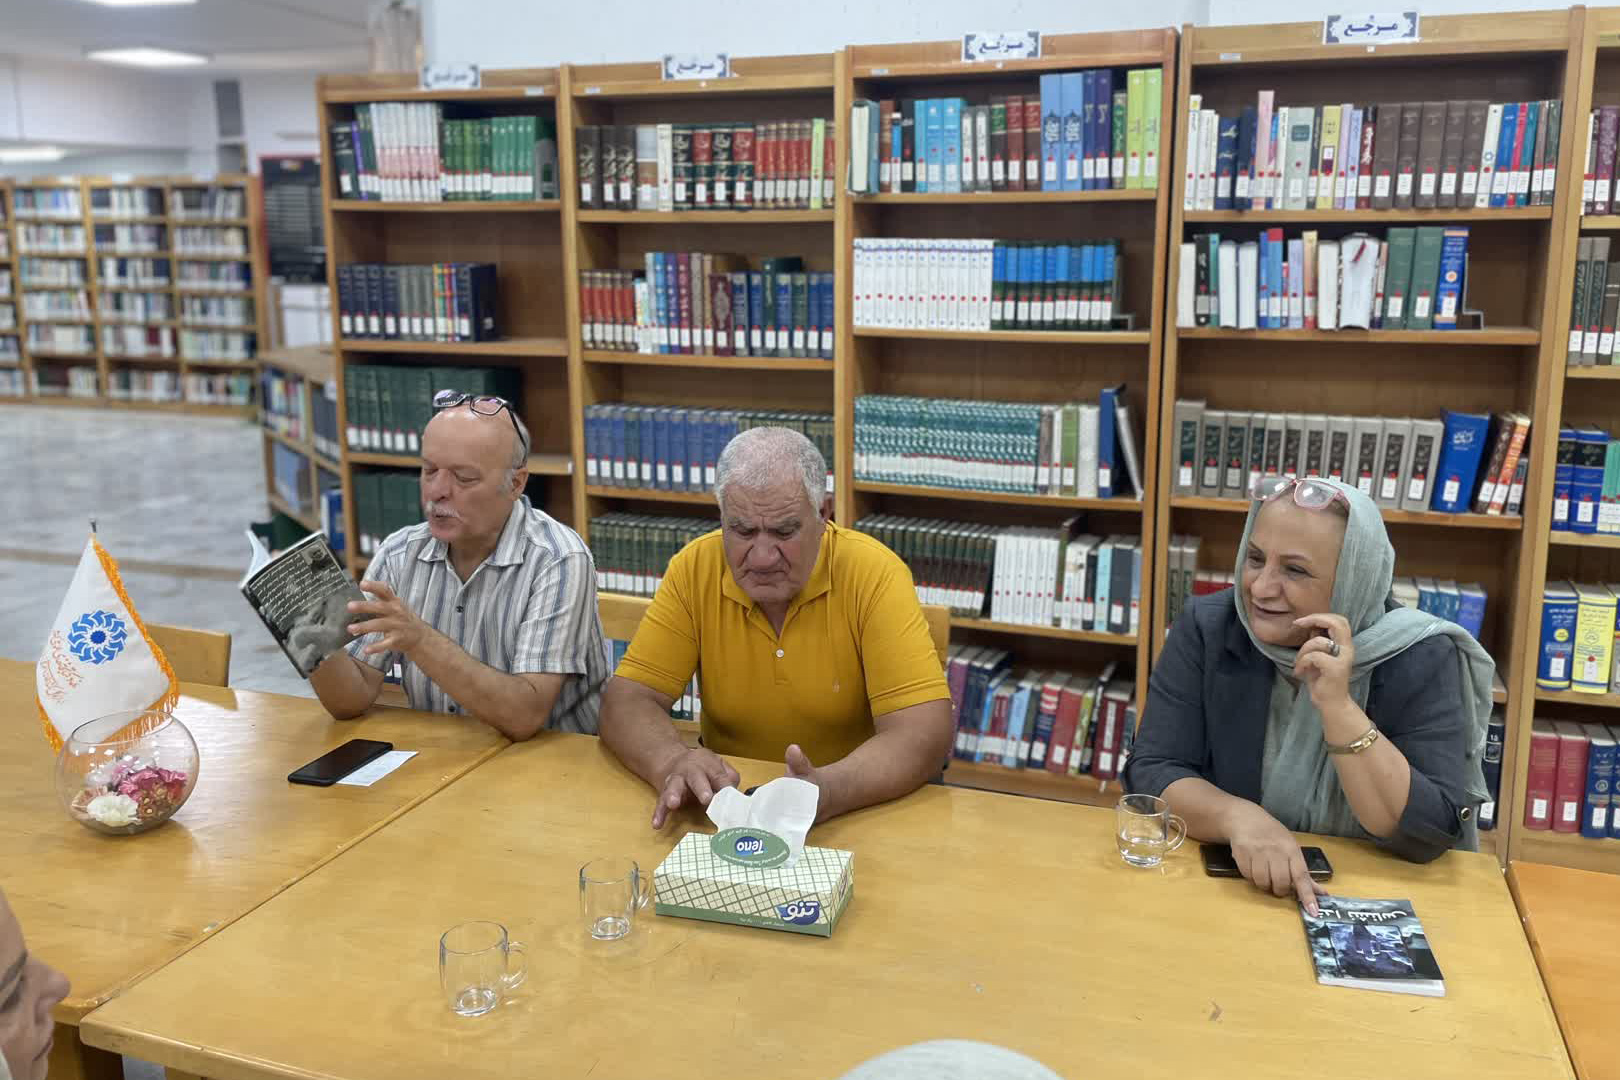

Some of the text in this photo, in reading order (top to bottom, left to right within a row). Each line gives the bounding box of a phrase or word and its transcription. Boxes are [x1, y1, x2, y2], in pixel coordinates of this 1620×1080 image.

[1344, 23, 1398, 36] مرجع
[736, 839, 764, 855] Teno
[782, 901, 818, 921] تنو
[1347, 910, 1408, 922] نشناس
